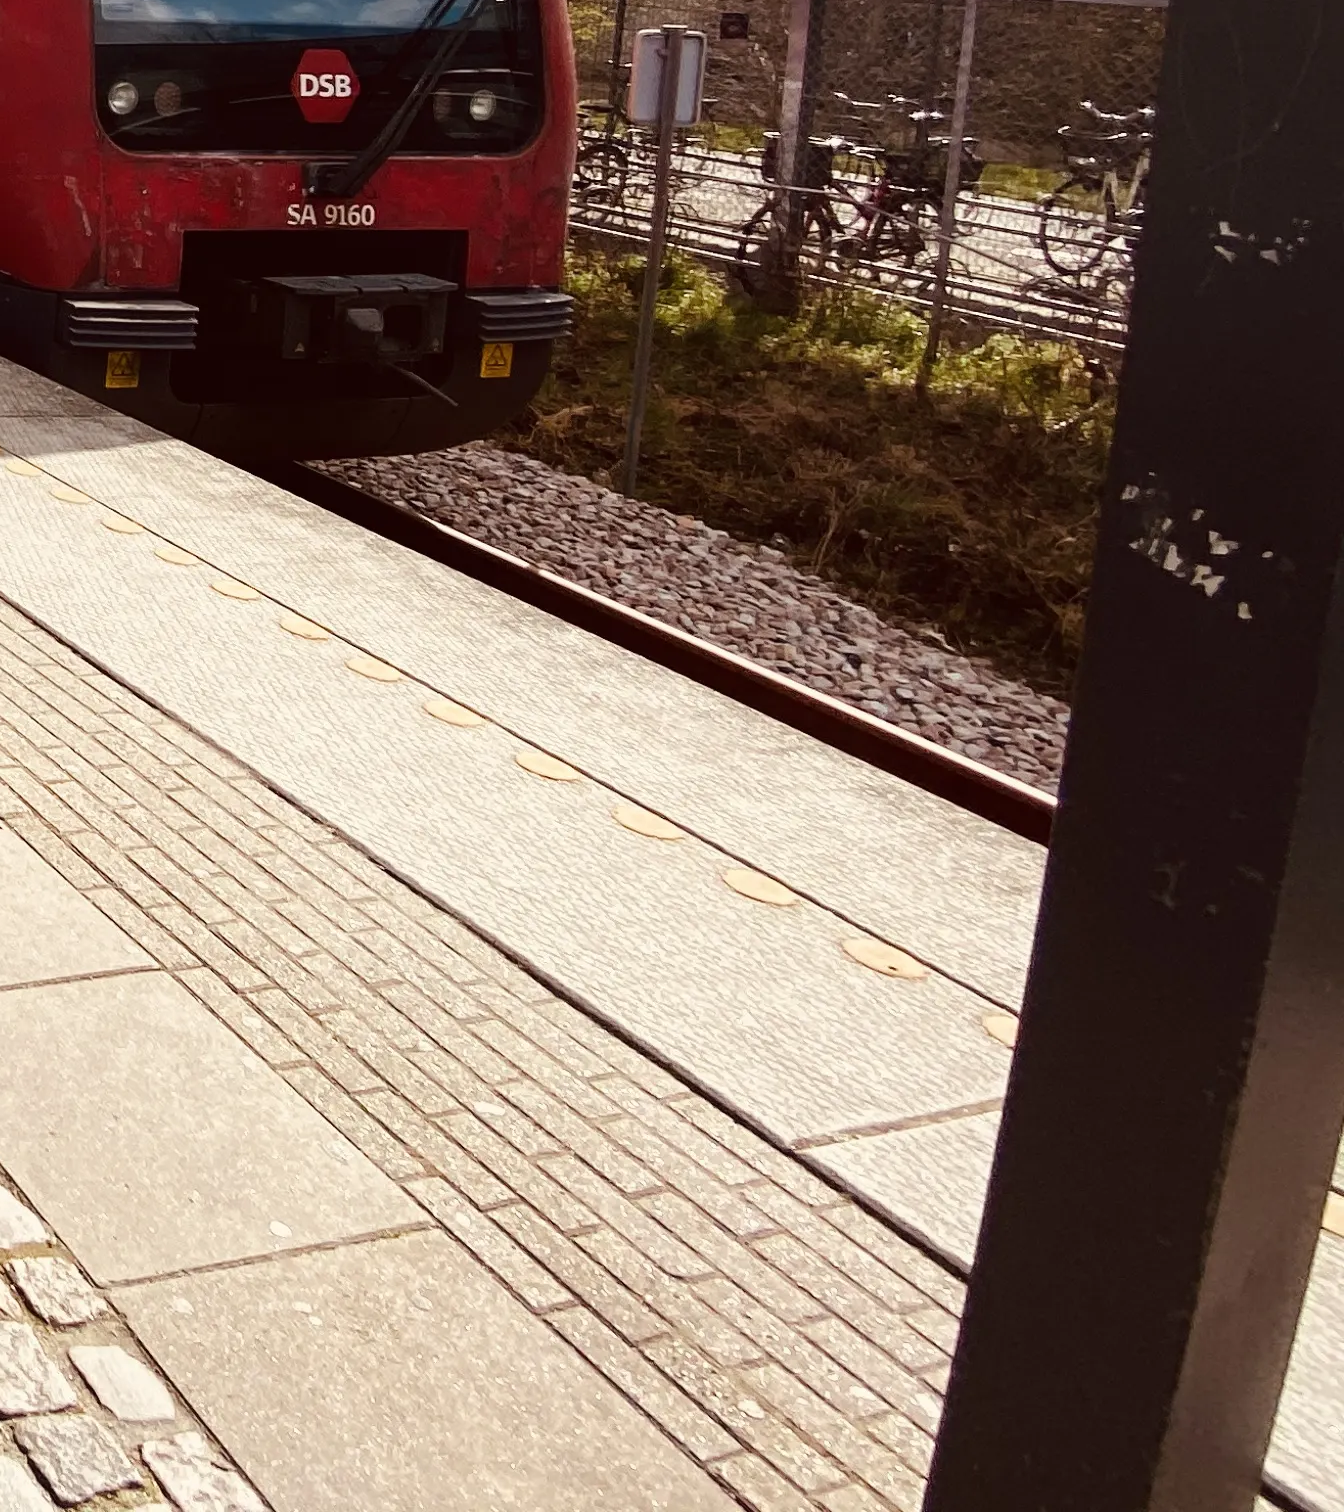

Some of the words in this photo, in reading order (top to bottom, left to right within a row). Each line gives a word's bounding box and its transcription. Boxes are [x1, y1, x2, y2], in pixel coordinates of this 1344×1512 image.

[299, 74, 352, 97] DSB
[287, 204, 317, 226] SA
[324, 204, 375, 226] 9160
